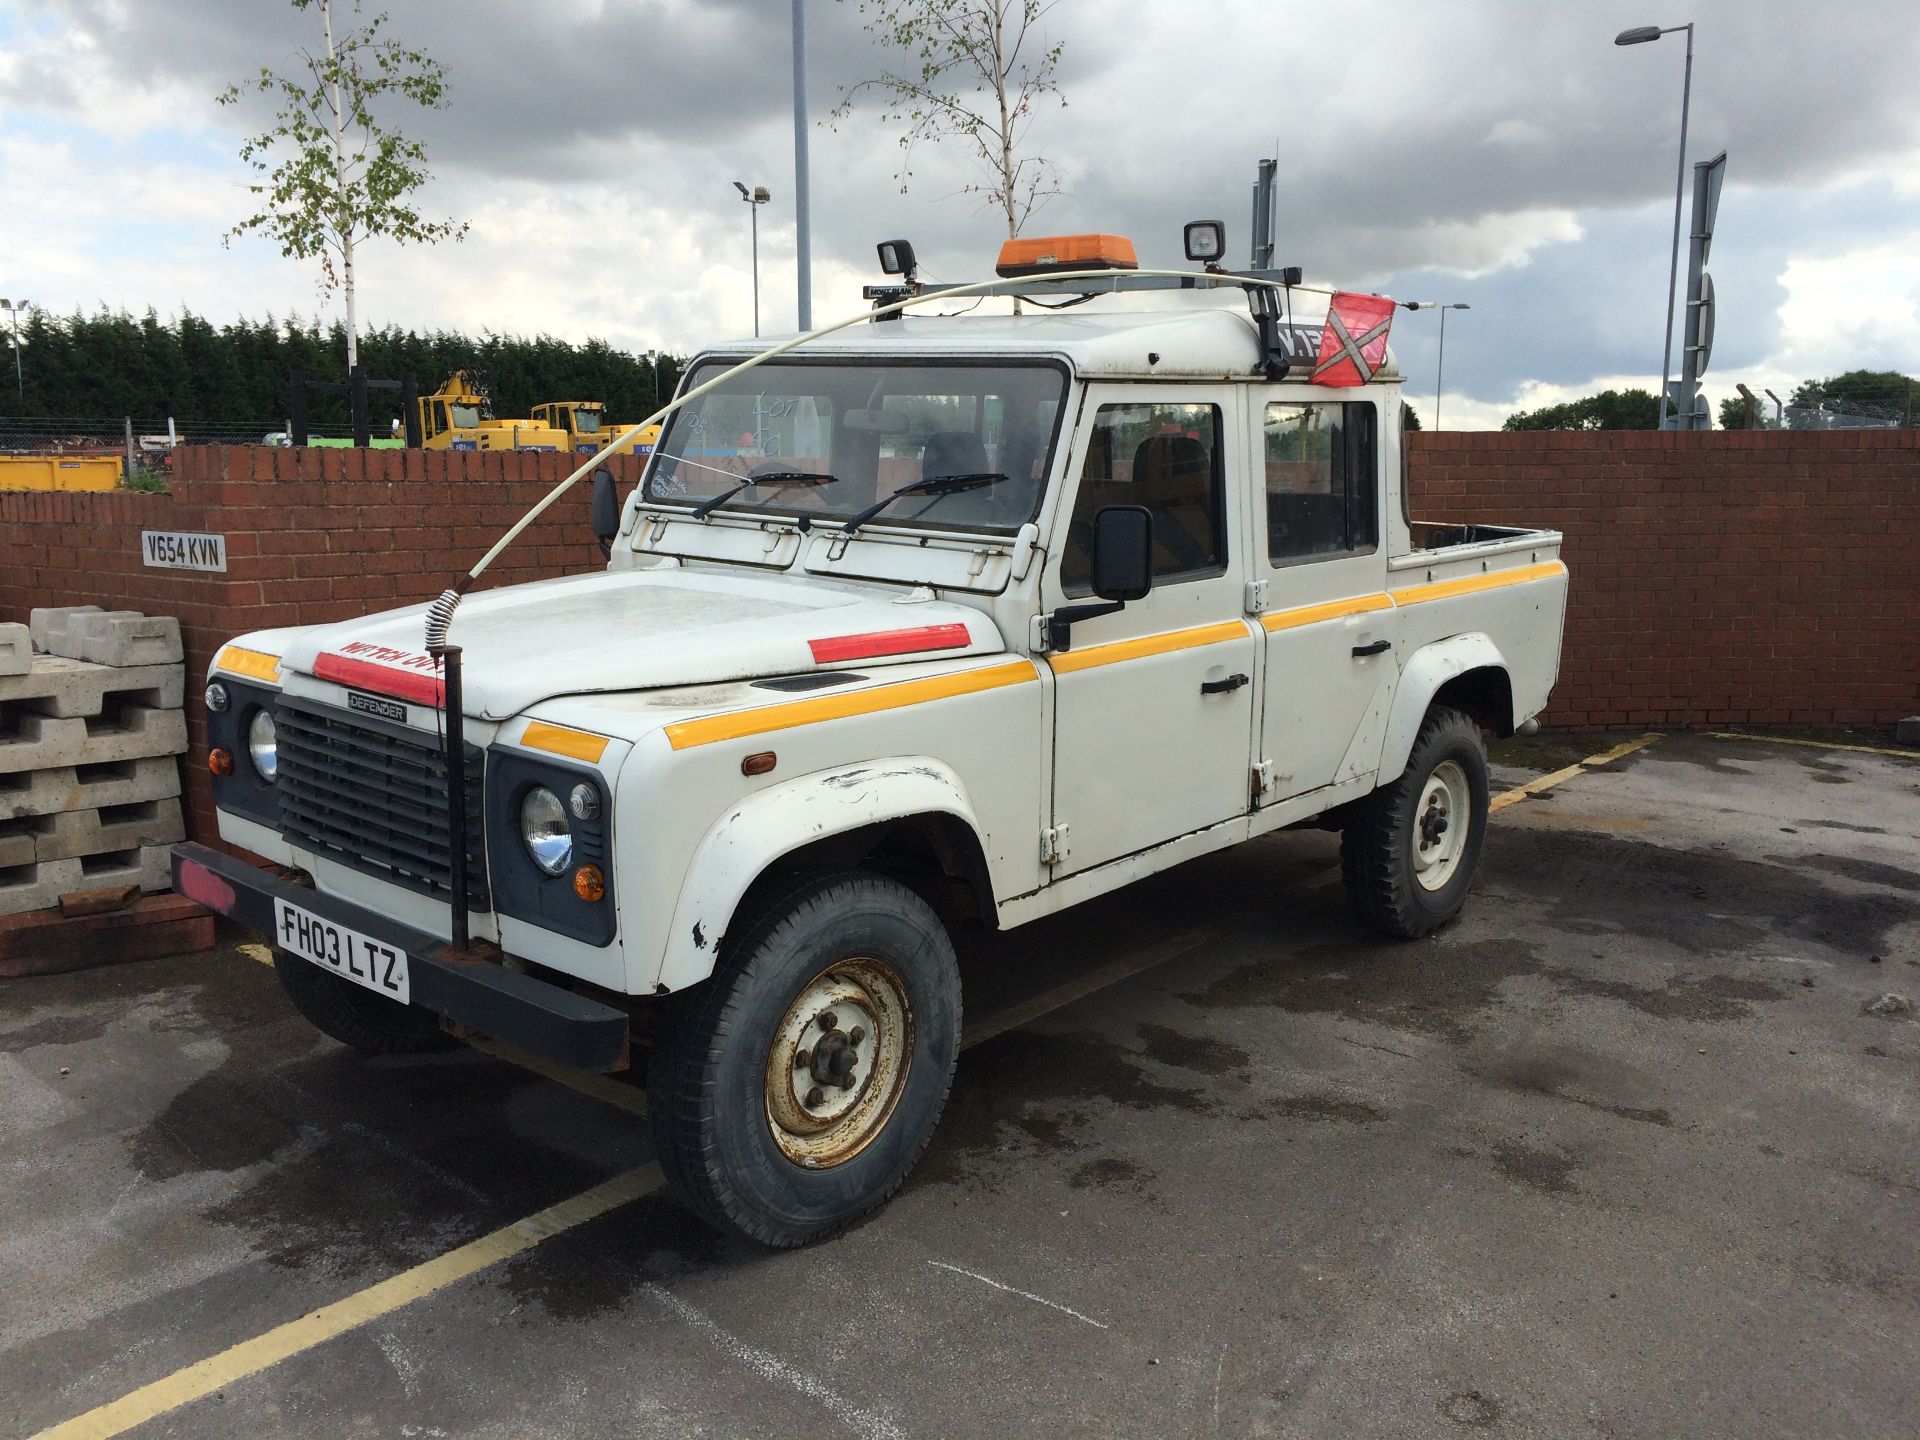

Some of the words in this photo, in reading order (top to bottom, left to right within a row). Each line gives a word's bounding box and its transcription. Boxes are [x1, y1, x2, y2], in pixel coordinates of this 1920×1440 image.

[148, 535, 185, 563] V654
[188, 537, 219, 567] KVN
[339, 642, 411, 662] WATCH
[350, 695, 403, 720] DEFENDER
[283, 905, 341, 967] FH03
[347, 934, 399, 992] LTZ
